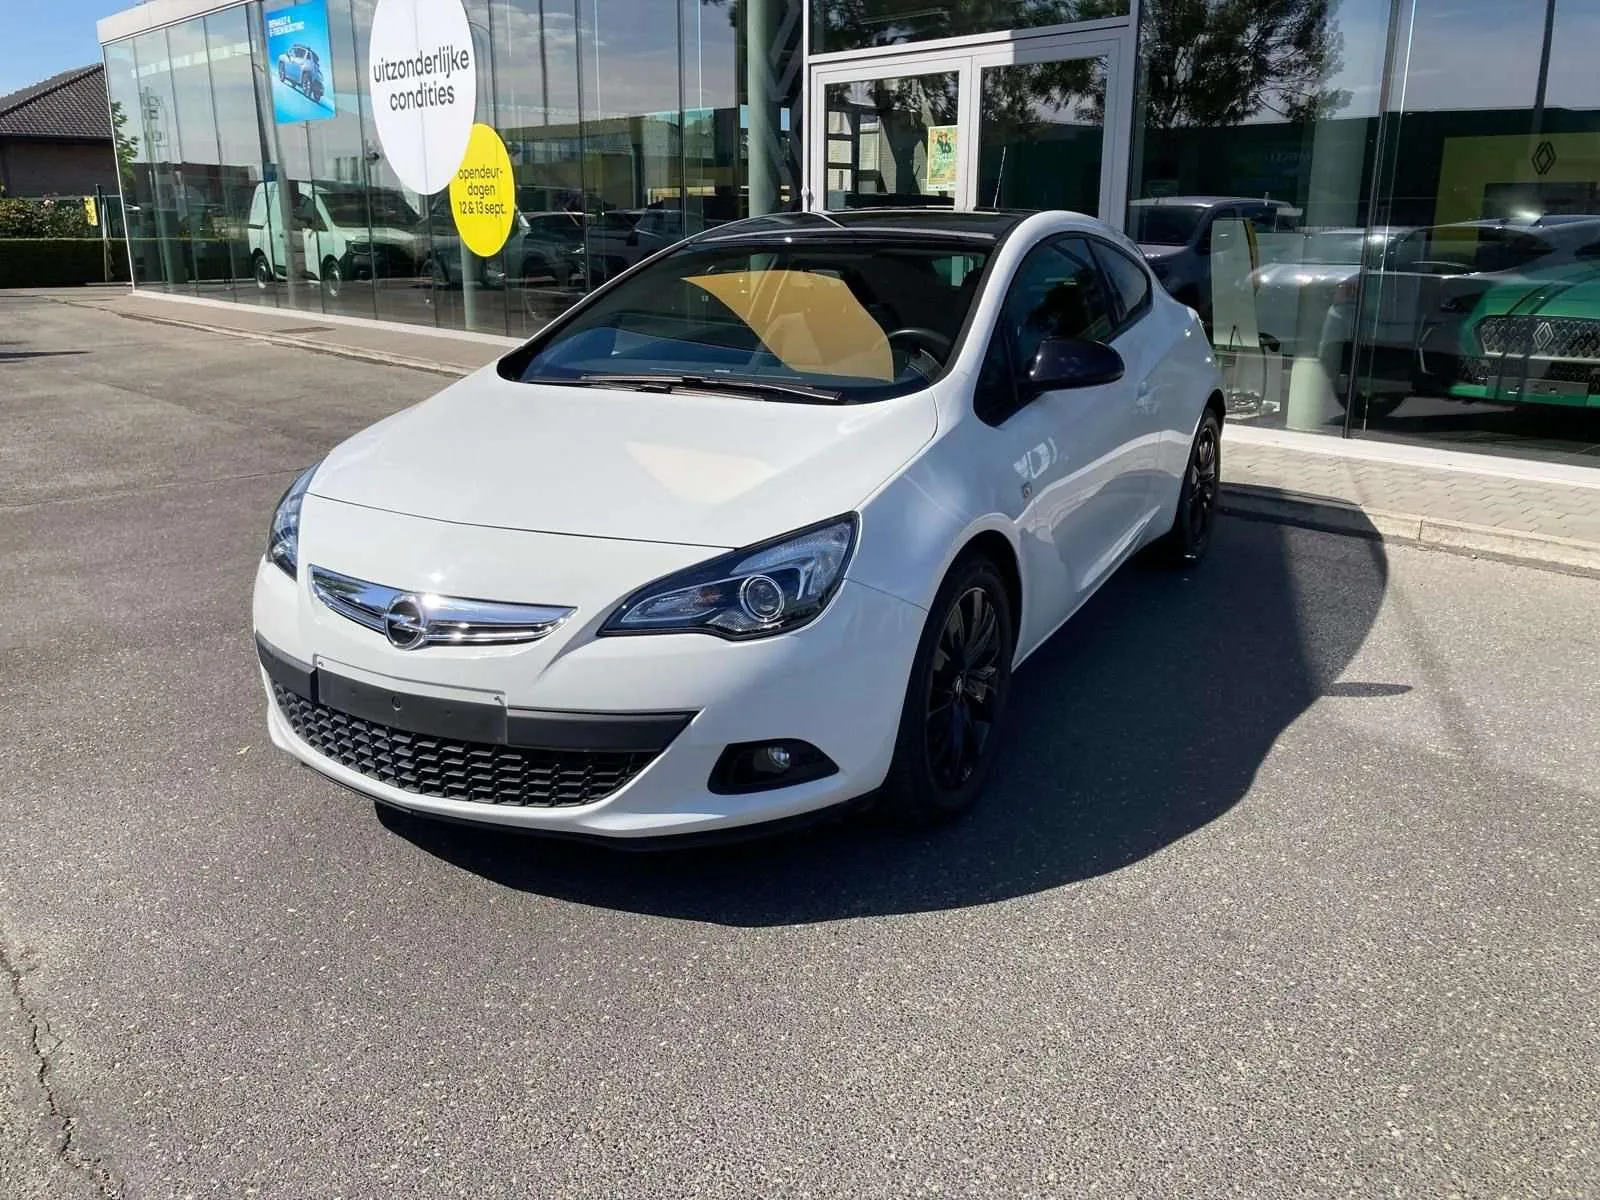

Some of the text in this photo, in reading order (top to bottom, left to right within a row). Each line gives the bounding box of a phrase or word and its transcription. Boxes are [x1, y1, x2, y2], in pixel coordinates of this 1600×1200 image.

[373, 44, 470, 83] uitzonderlijke
[390, 80, 455, 111] condities
[458, 164, 504, 182] opendeur-
[467, 181, 496, 199] dagen
[458, 200, 507, 219] 12 & 13 sept.
